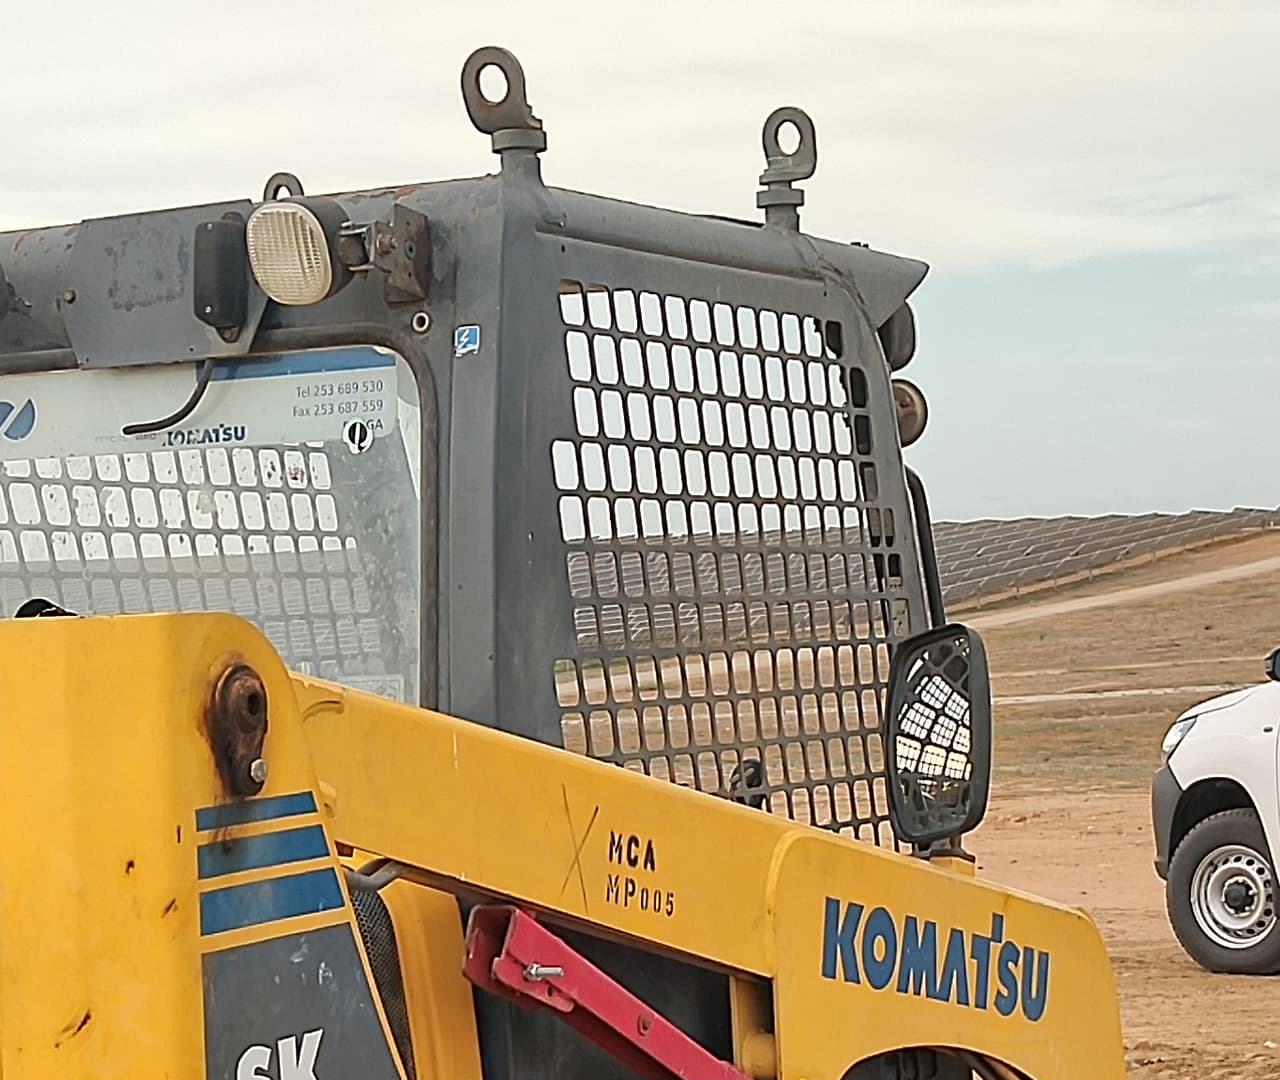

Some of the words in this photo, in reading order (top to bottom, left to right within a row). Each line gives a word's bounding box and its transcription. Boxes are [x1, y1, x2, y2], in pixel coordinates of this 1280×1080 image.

[292, 405, 311, 417] Fax
[313, 403, 335, 416] 253
[337, 401, 359, 414] 687
[362, 399, 384, 412] 559
[296, 386, 311, 398] Tel
[313, 384, 334, 397] 253
[337, 382, 359, 395] 689
[362, 380, 384, 393] 530
[608, 829, 656, 872] MCA
[606, 873, 674, 917] MP005
[821, 896, 1050, 1023] KOMATSU
